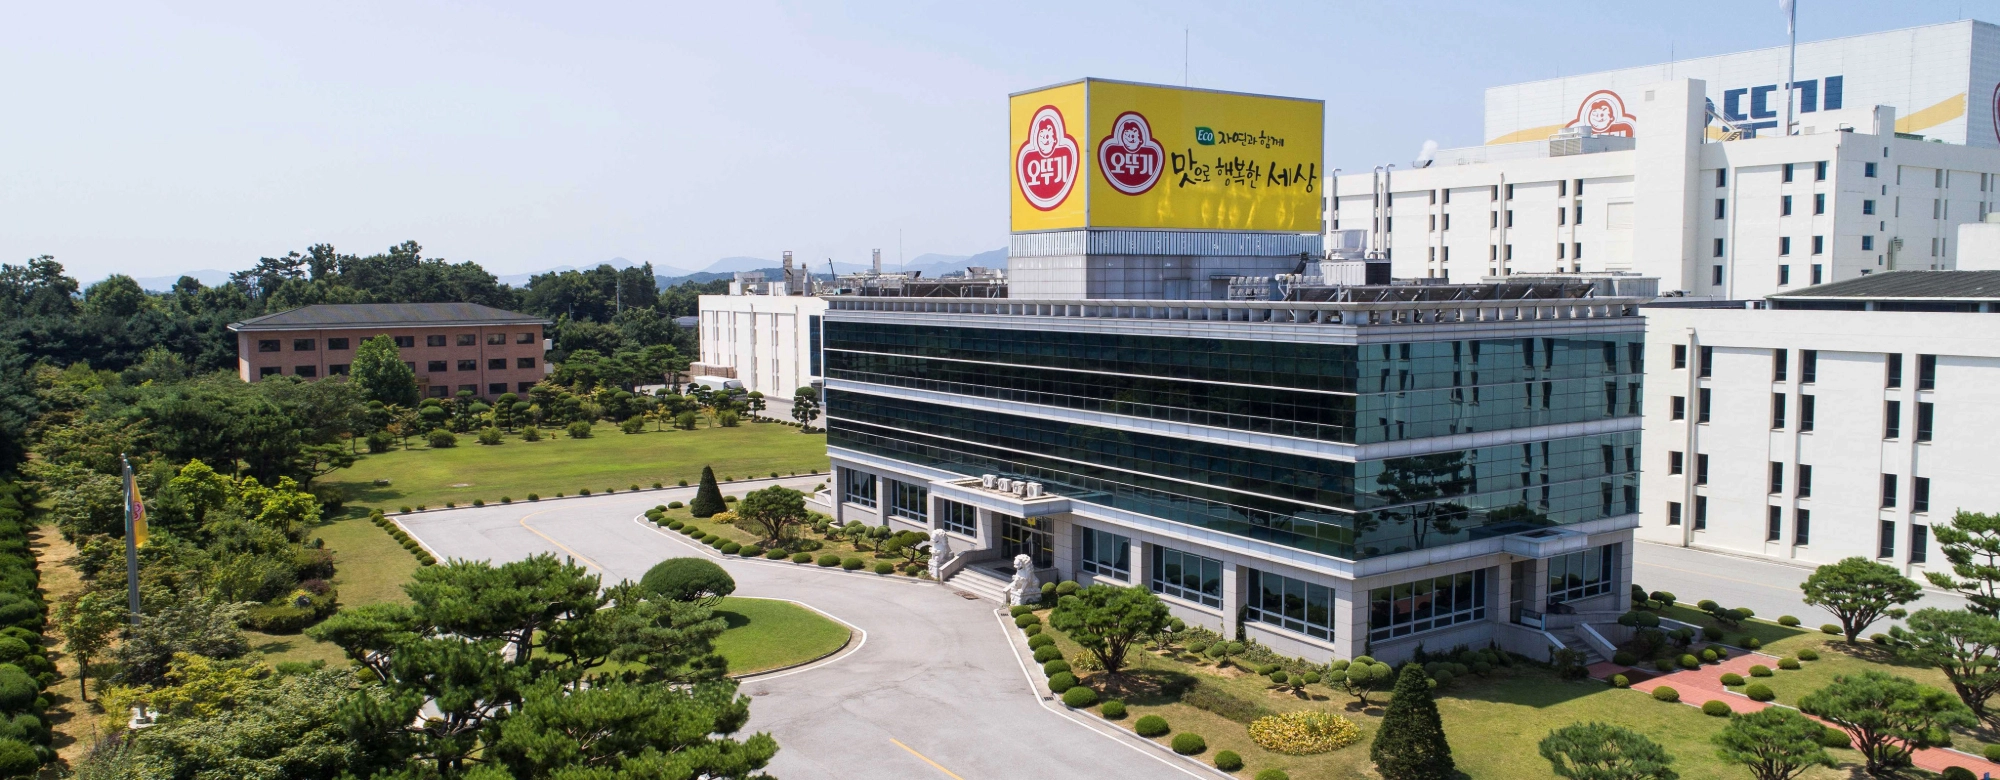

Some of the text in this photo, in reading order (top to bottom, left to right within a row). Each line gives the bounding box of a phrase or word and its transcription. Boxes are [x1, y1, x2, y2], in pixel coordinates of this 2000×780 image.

[1706, 75, 1843, 140] 뚜기
[1218, 130, 1284, 149] 자연과 함께
[1027, 155, 1068, 186] 오뚜기
[1110, 152, 1153, 176] 오뚜기
[1171, 148, 1317, 193] 맛으로 행복한 세상
